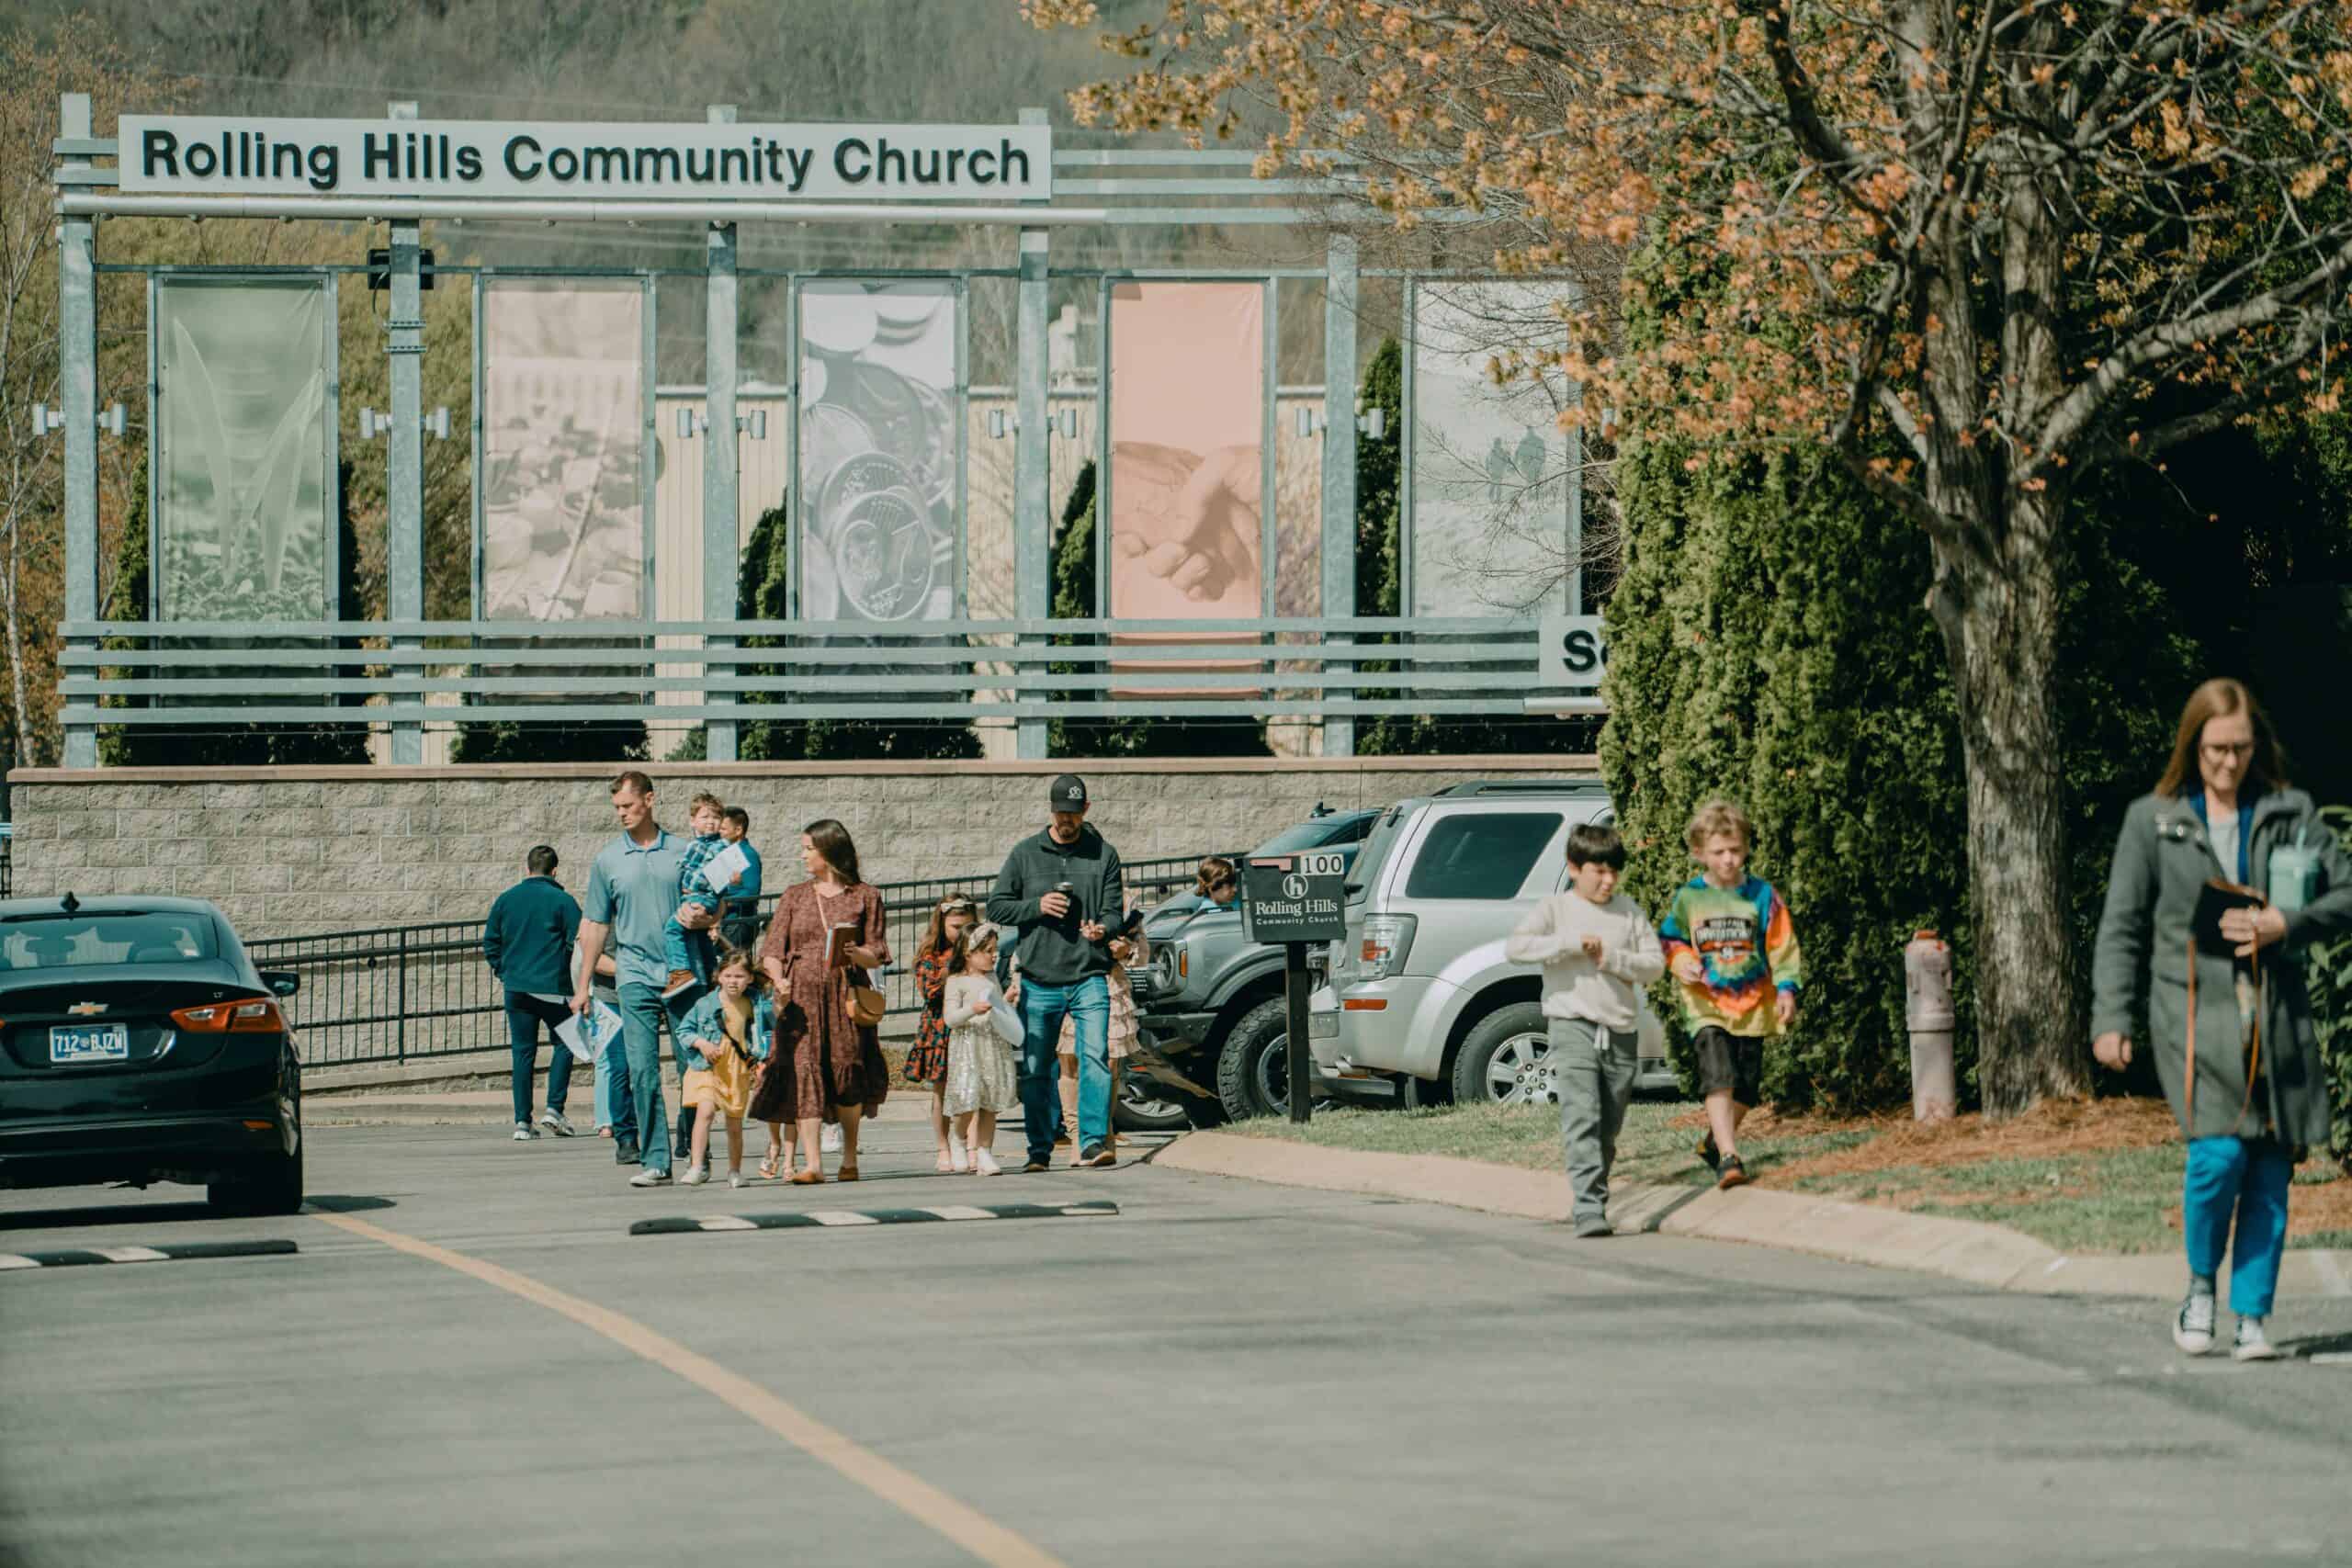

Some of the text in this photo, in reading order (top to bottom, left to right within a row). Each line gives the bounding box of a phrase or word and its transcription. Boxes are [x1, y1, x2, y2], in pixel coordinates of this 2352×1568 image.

[142, 130, 1030, 192] Rolling Hills Community Church
[1305, 856, 1342, 874] 100
[1255, 899, 1338, 917] Rolling Hills
[1256, 918, 1305, 926] Community
[55, 1034, 80, 1053] 712
